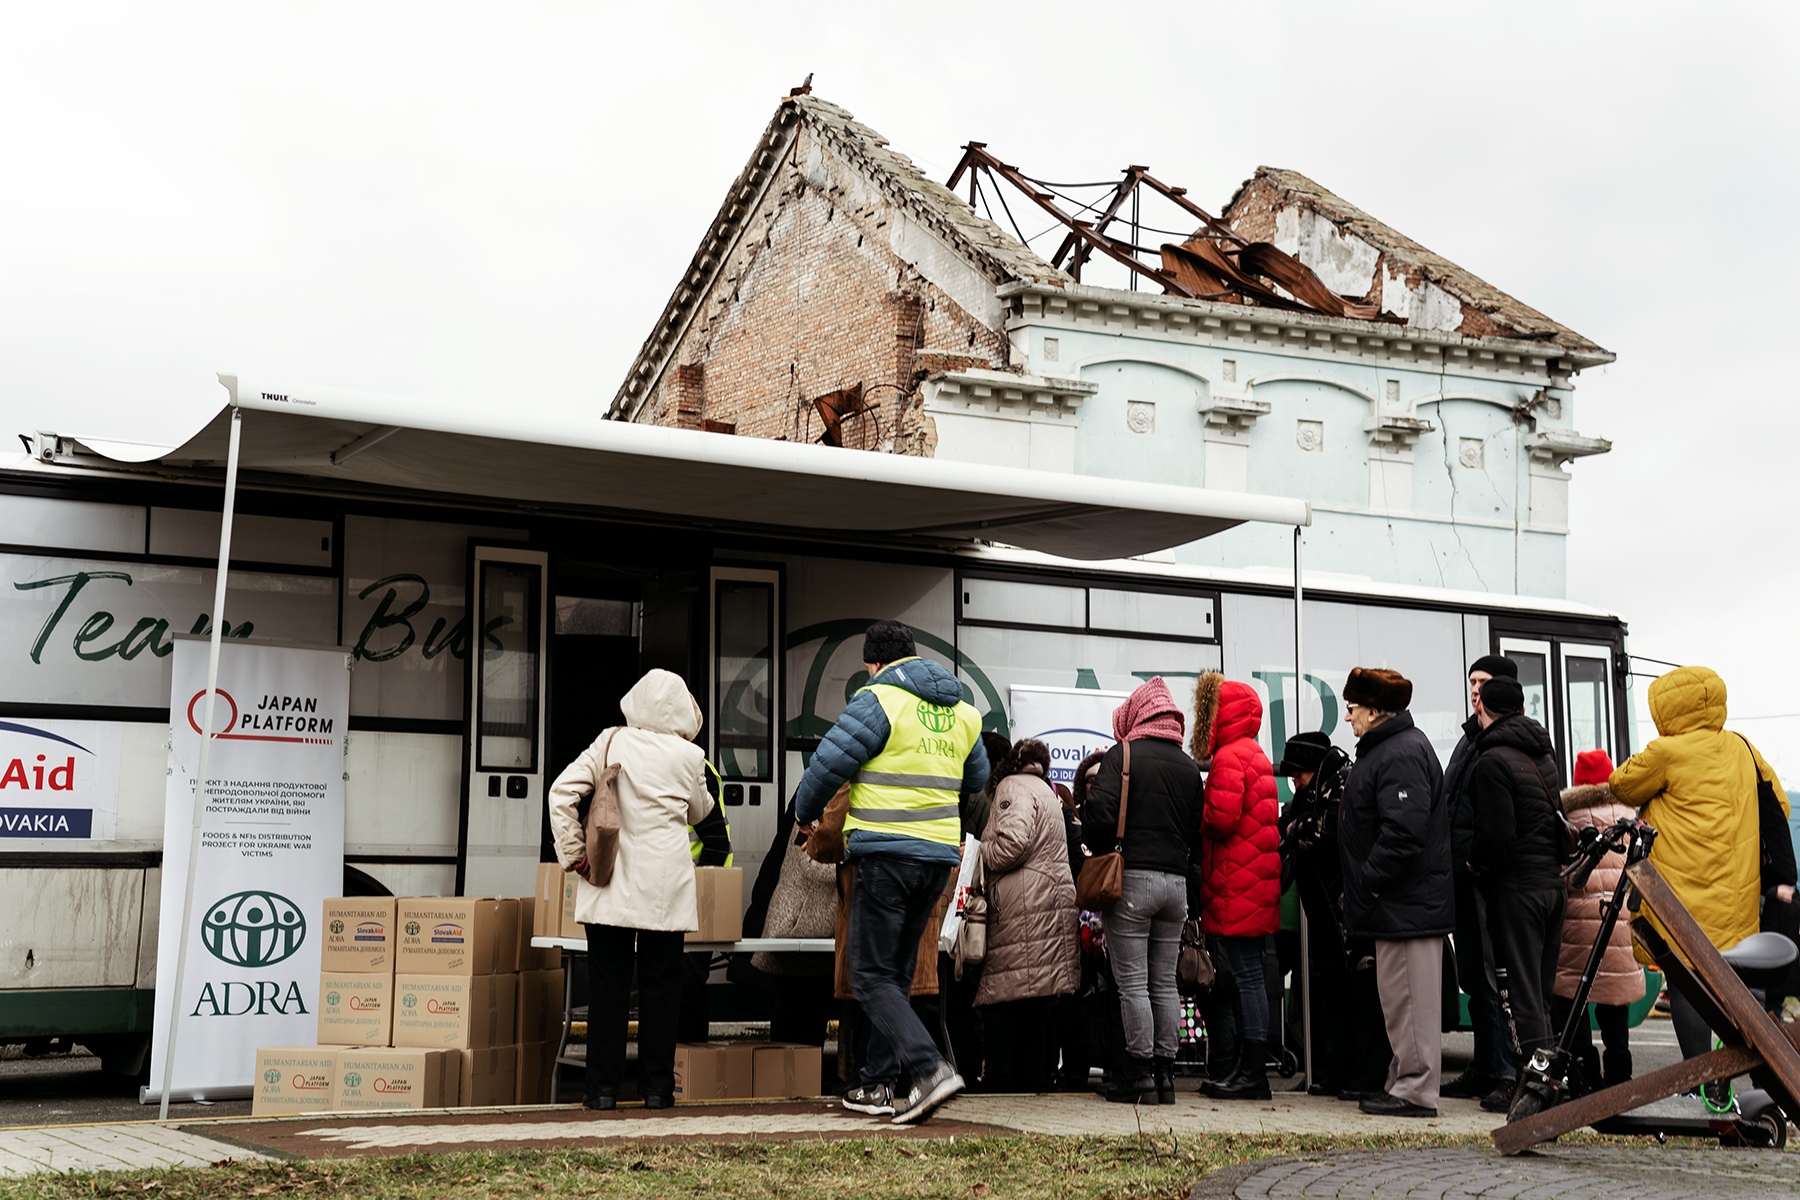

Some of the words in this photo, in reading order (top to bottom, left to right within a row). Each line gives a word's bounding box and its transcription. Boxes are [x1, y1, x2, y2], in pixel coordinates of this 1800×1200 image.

[261, 392, 289, 402] THULE
[353, 573, 514, 662] Bus
[257, 694, 318, 713] JAPAN
[240, 713, 334, 734] PLATFORM
[915, 737, 956, 758] ADRA
[189, 779, 221, 787] ПЄКТ
[272, 782, 328, 791] ПРОДУКТОВОЇ
[280, 791, 326, 799] ДОПОМОГИ
[254, 798, 292, 806] УКРАЇНИ,
[205, 806, 269, 814] ПОСТРАЖДАЛИ
[286, 807, 311, 815] ВІЙНИ
[0, 814, 70, 832] VAKIA
[202, 832, 231, 840] FOODS
[232, 832, 238, 840] &
[258, 833, 312, 841] DISTRIBUTION
[328, 910, 375, 918] HUMANITARIAN
[375, 910, 387, 918] AID
[403, 911, 454, 919] HUMANITARIAN
[454, 912, 467, 920] AID
[188, 980, 311, 1017] ADRA
[263, 1059, 318, 1067] HUMANITARIAN
[318, 1059, 333, 1067] AID
[343, 1061, 400, 1070] HUMANITARIAN
[400, 1063, 415, 1071] AID
